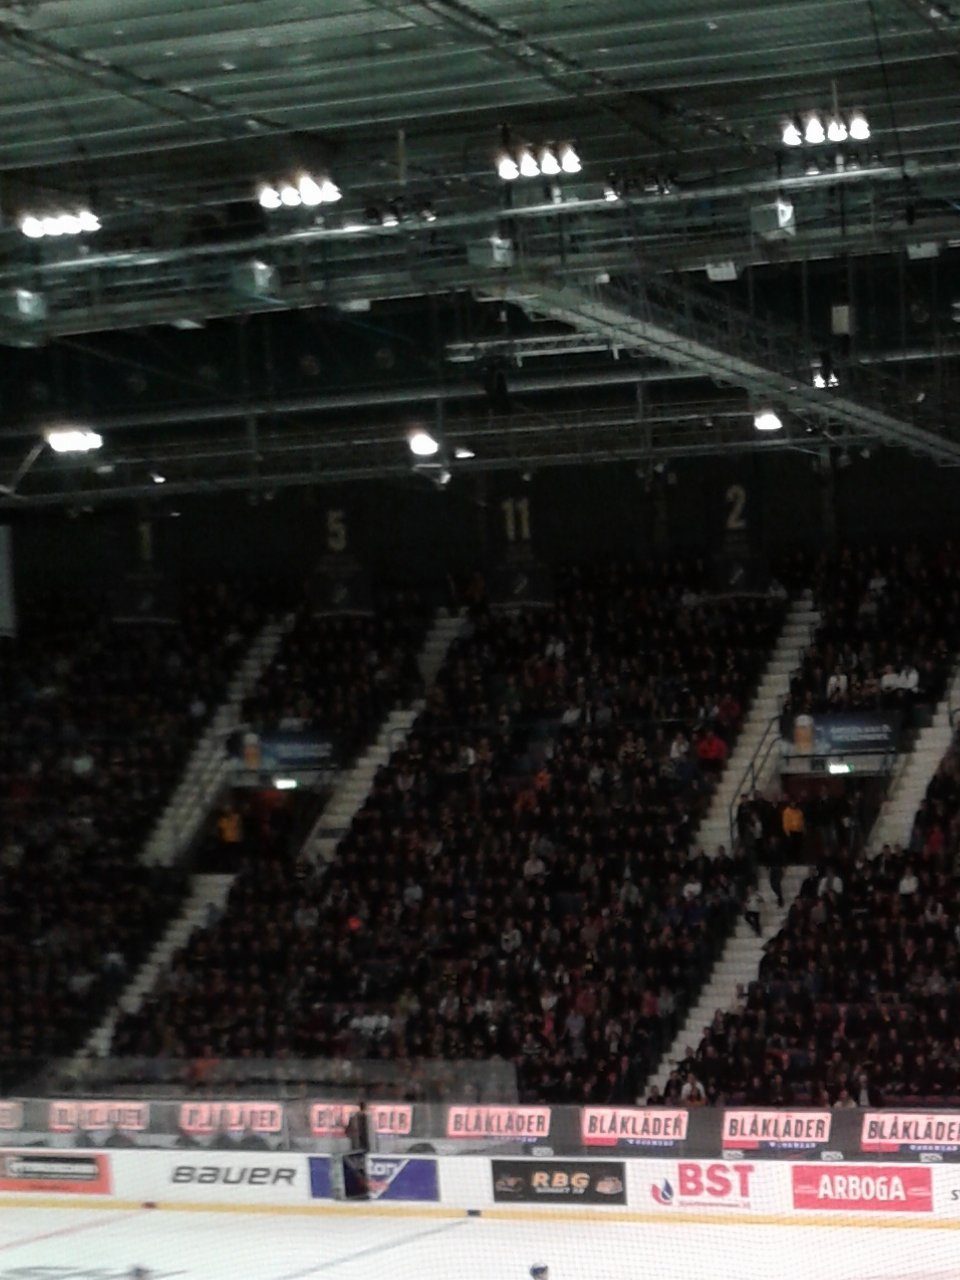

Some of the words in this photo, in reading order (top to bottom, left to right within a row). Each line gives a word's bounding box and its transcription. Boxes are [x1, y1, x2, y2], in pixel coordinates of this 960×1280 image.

[499, 498, 532, 541] 11
[727, 484, 747, 530] 2
[328, 509, 346, 551] 5
[453, 1111, 546, 1133] BLÅKLÄDER
[588, 1110, 682, 1137] BLÅKLÄDER
[728, 1113, 826, 1139] BLÅKLÄDER
[532, 1171, 590, 1188] RBG
[677, 1163, 755, 1198] BST
[818, 1173, 907, 1202] ARBOGA
